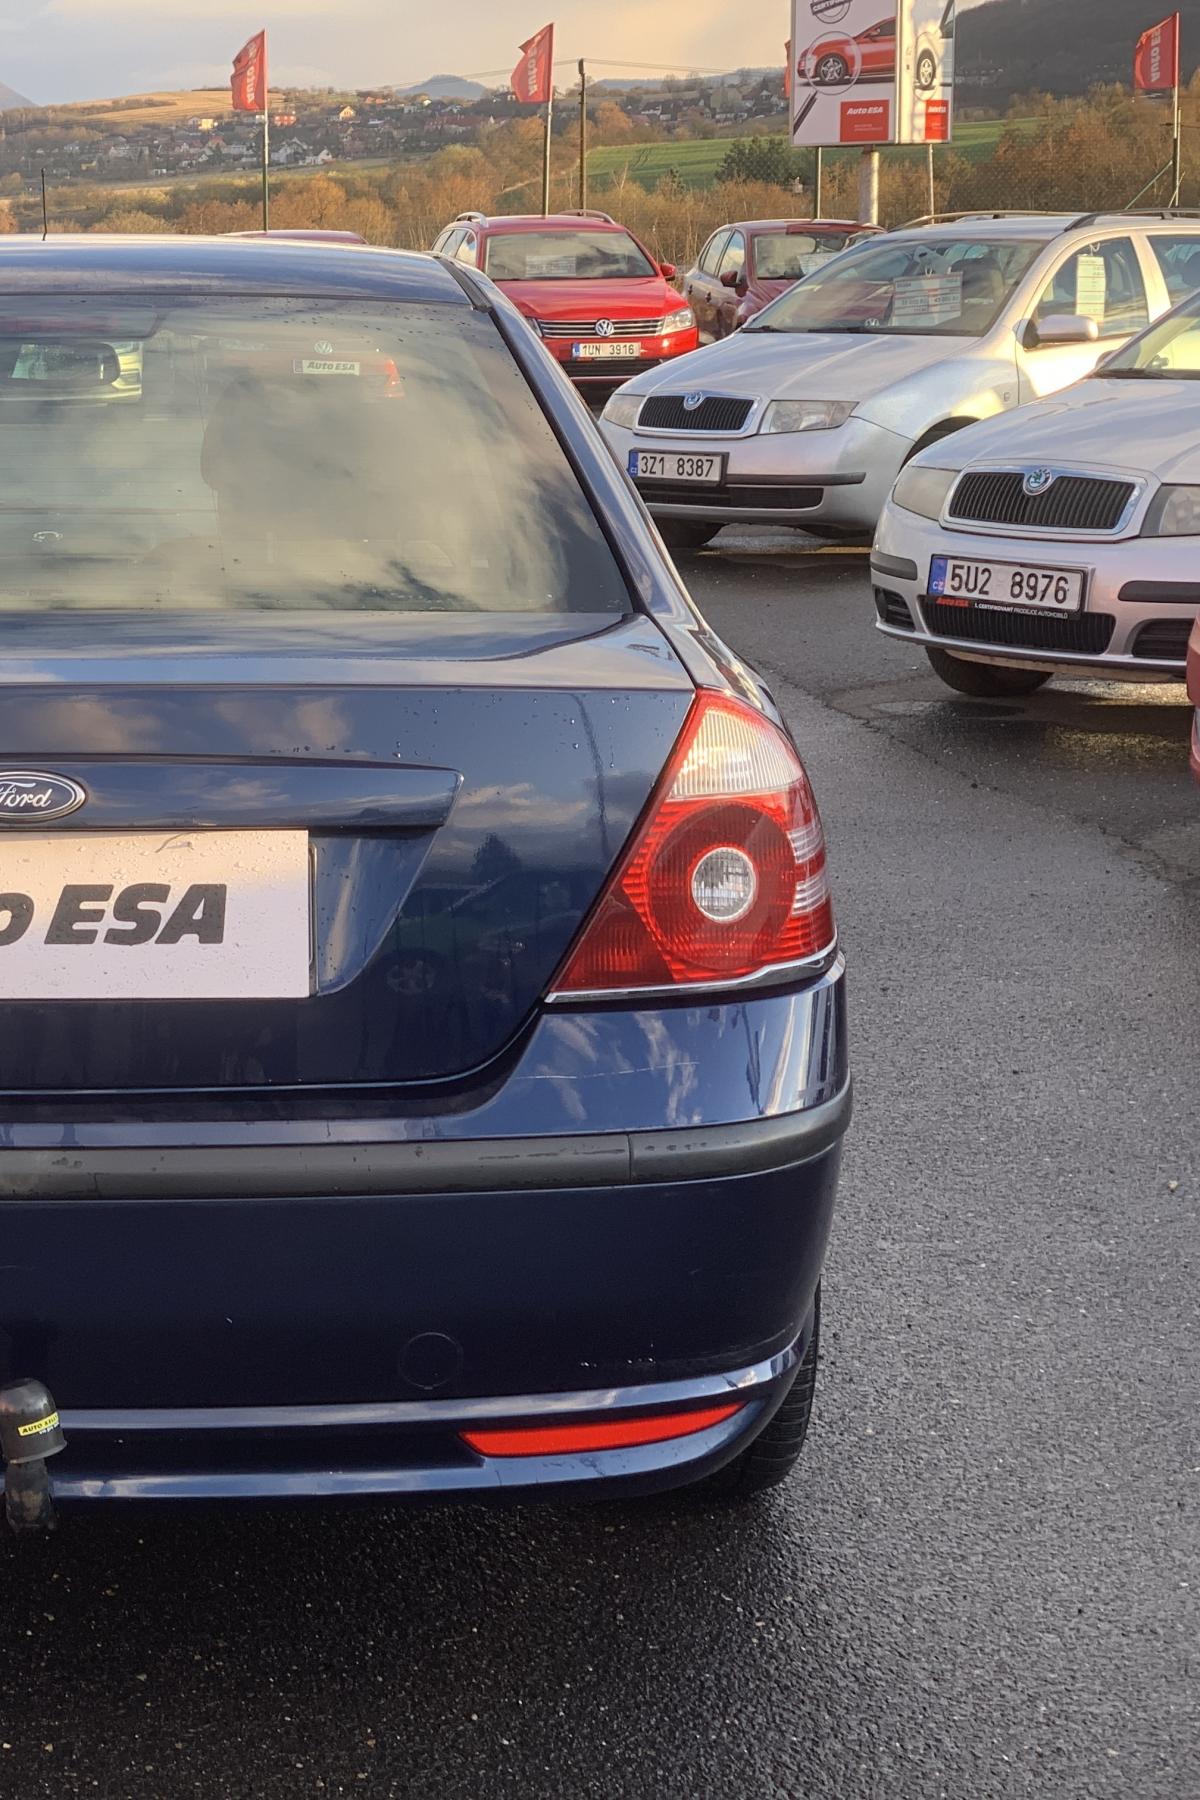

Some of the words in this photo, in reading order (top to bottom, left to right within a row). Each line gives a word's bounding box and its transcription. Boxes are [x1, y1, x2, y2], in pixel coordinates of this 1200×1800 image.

[847, 107, 867, 116] Auto
[868, 106, 883, 114] ESA
[582, 344, 601, 356] 1UN
[609, 344, 634, 355] 3916
[335, 362, 356, 371] ESA
[641, 456, 664, 475] 3Z1
[677, 457, 714, 477] 8387
[932, 581, 944, 591] CZ
[950, 564, 992, 596] 5U2
[1010, 571, 1068, 604] 8976
[43, 883, 227, 946] ESA
[22, 1423, 43, 1434] AUTO
